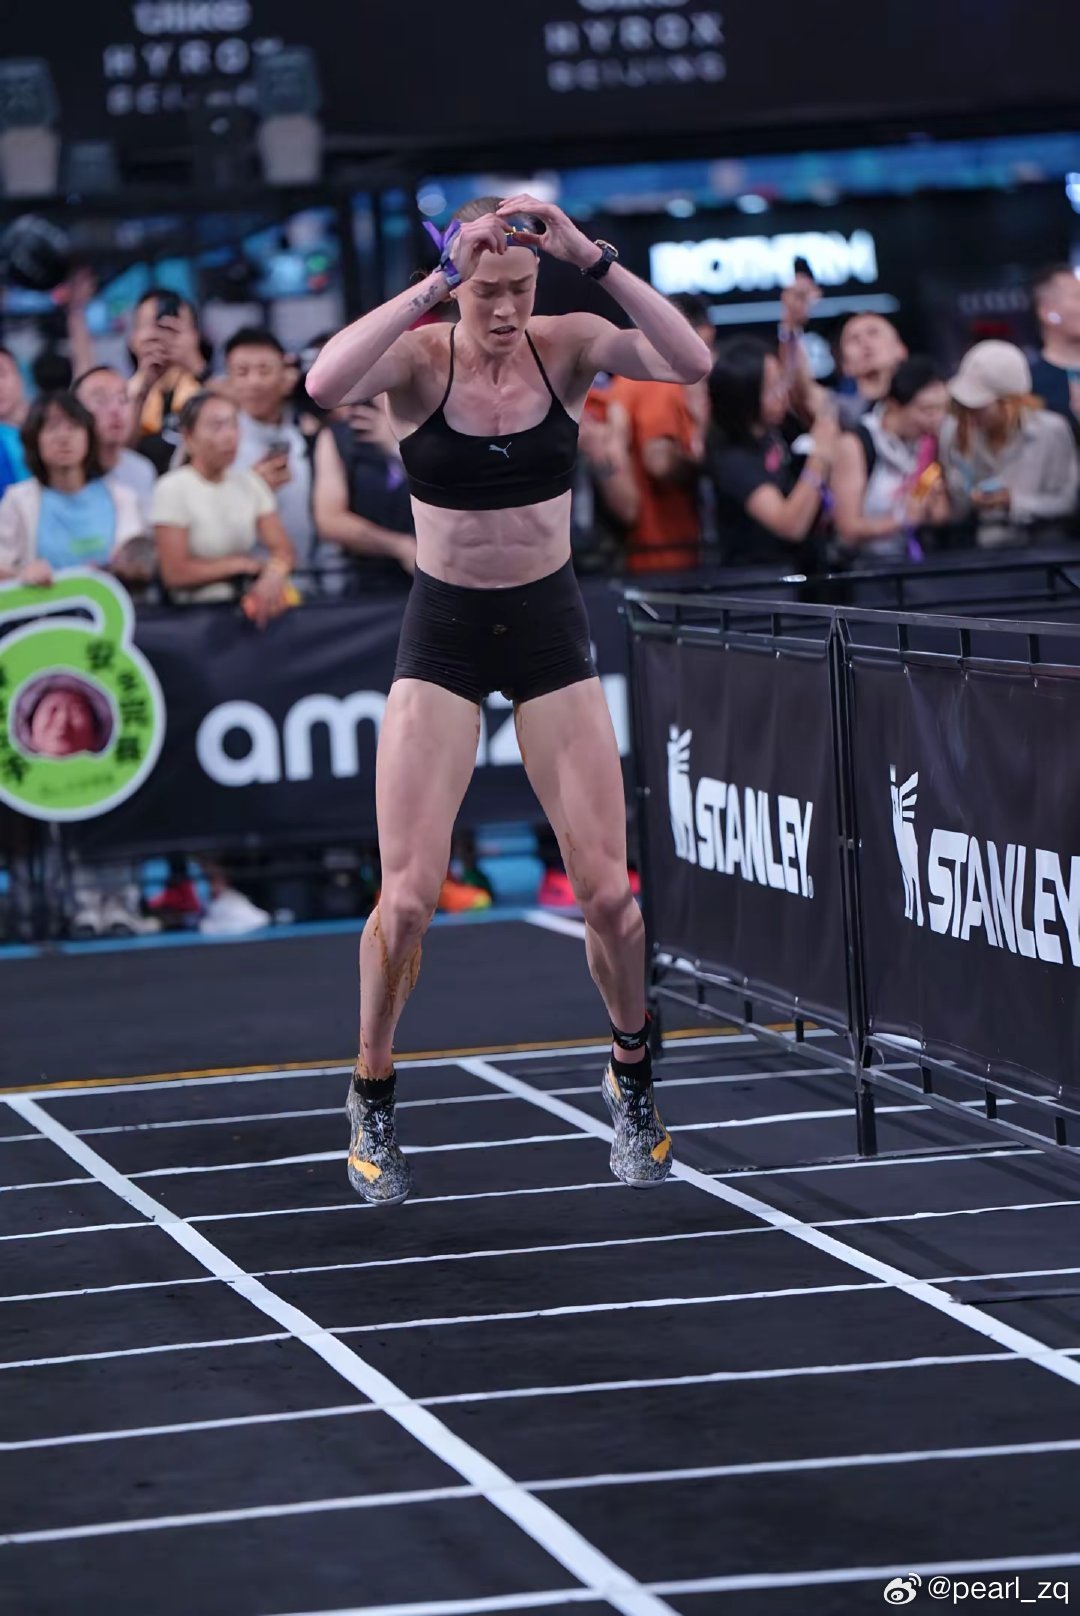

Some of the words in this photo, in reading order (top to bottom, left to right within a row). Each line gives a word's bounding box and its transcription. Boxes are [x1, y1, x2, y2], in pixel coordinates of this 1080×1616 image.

[544, 12, 724, 54] HYROX
[695, 776, 814, 898] STANLEY
[928, 829, 1080, 967] STANLEY
